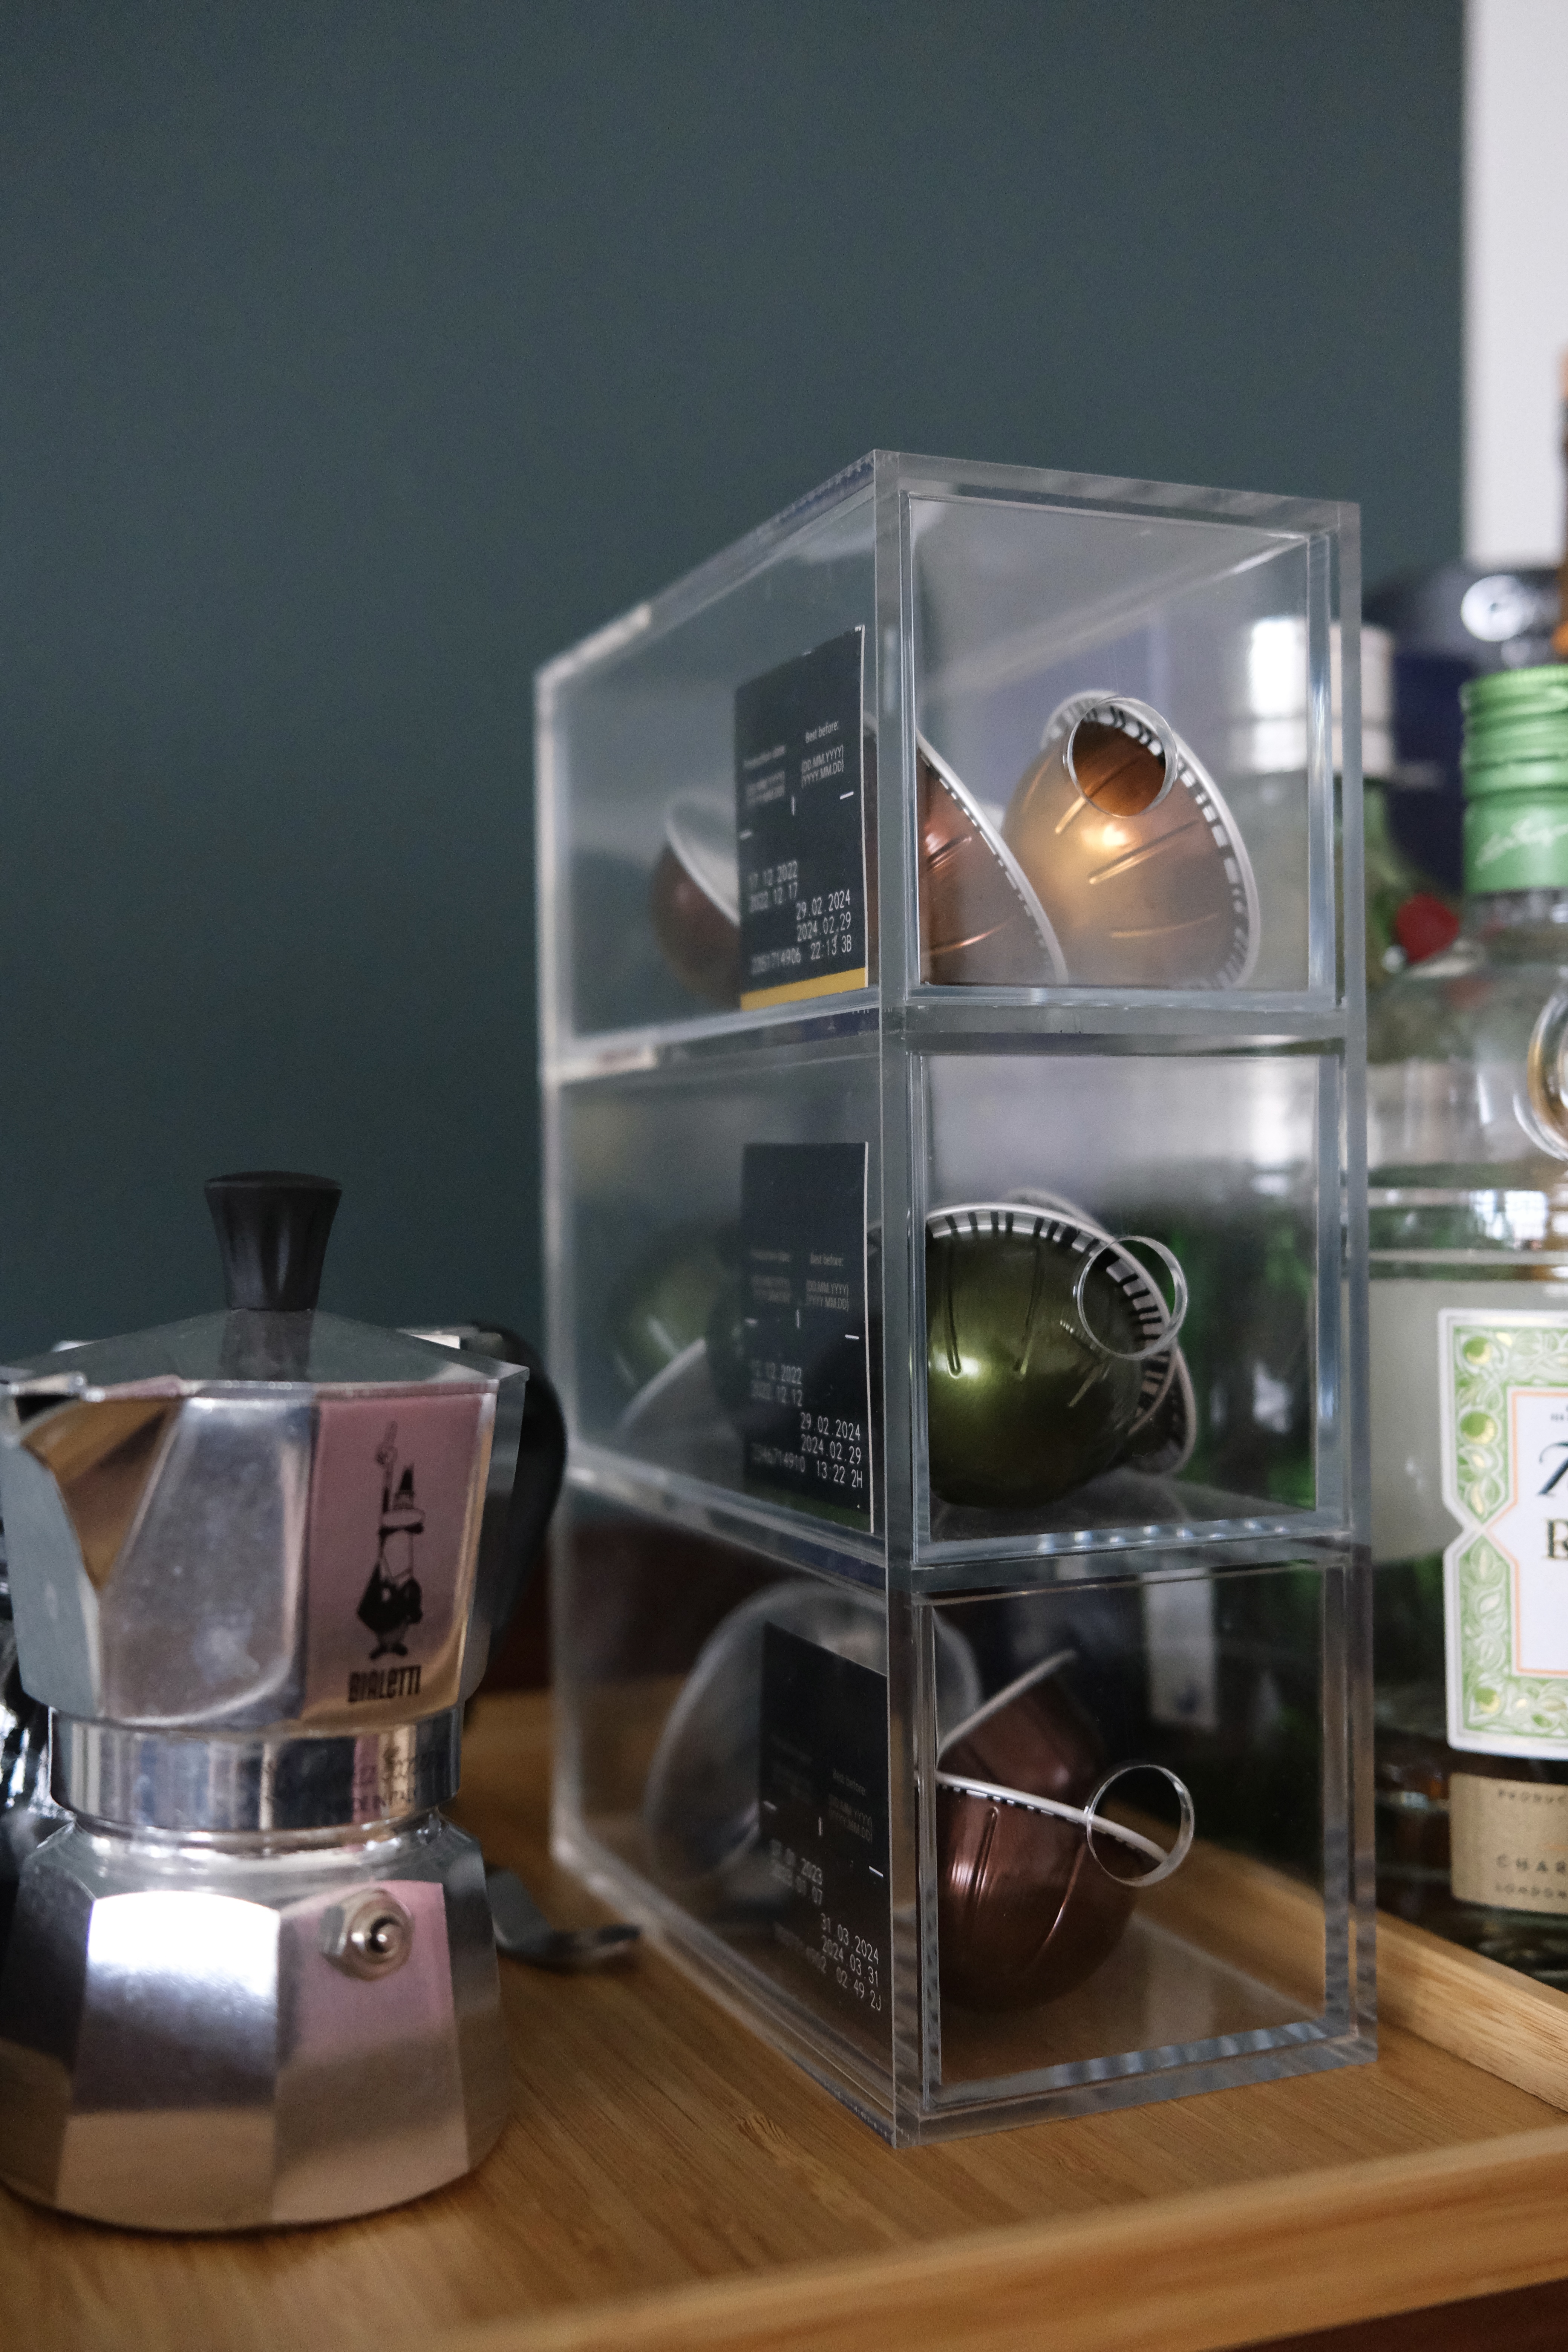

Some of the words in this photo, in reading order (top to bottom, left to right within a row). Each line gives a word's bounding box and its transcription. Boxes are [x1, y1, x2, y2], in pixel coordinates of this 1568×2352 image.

[796, 890, 850, 920] 29.02.2024
[797, 911, 851, 942] 2024.02.29
[801, 1412, 861, 1441] 29.02.2024
[802, 1434, 861, 1464] 2024.02.29
[817, 1460, 845, 1484] 13:22
[851, 1469, 862, 1488] 2H
